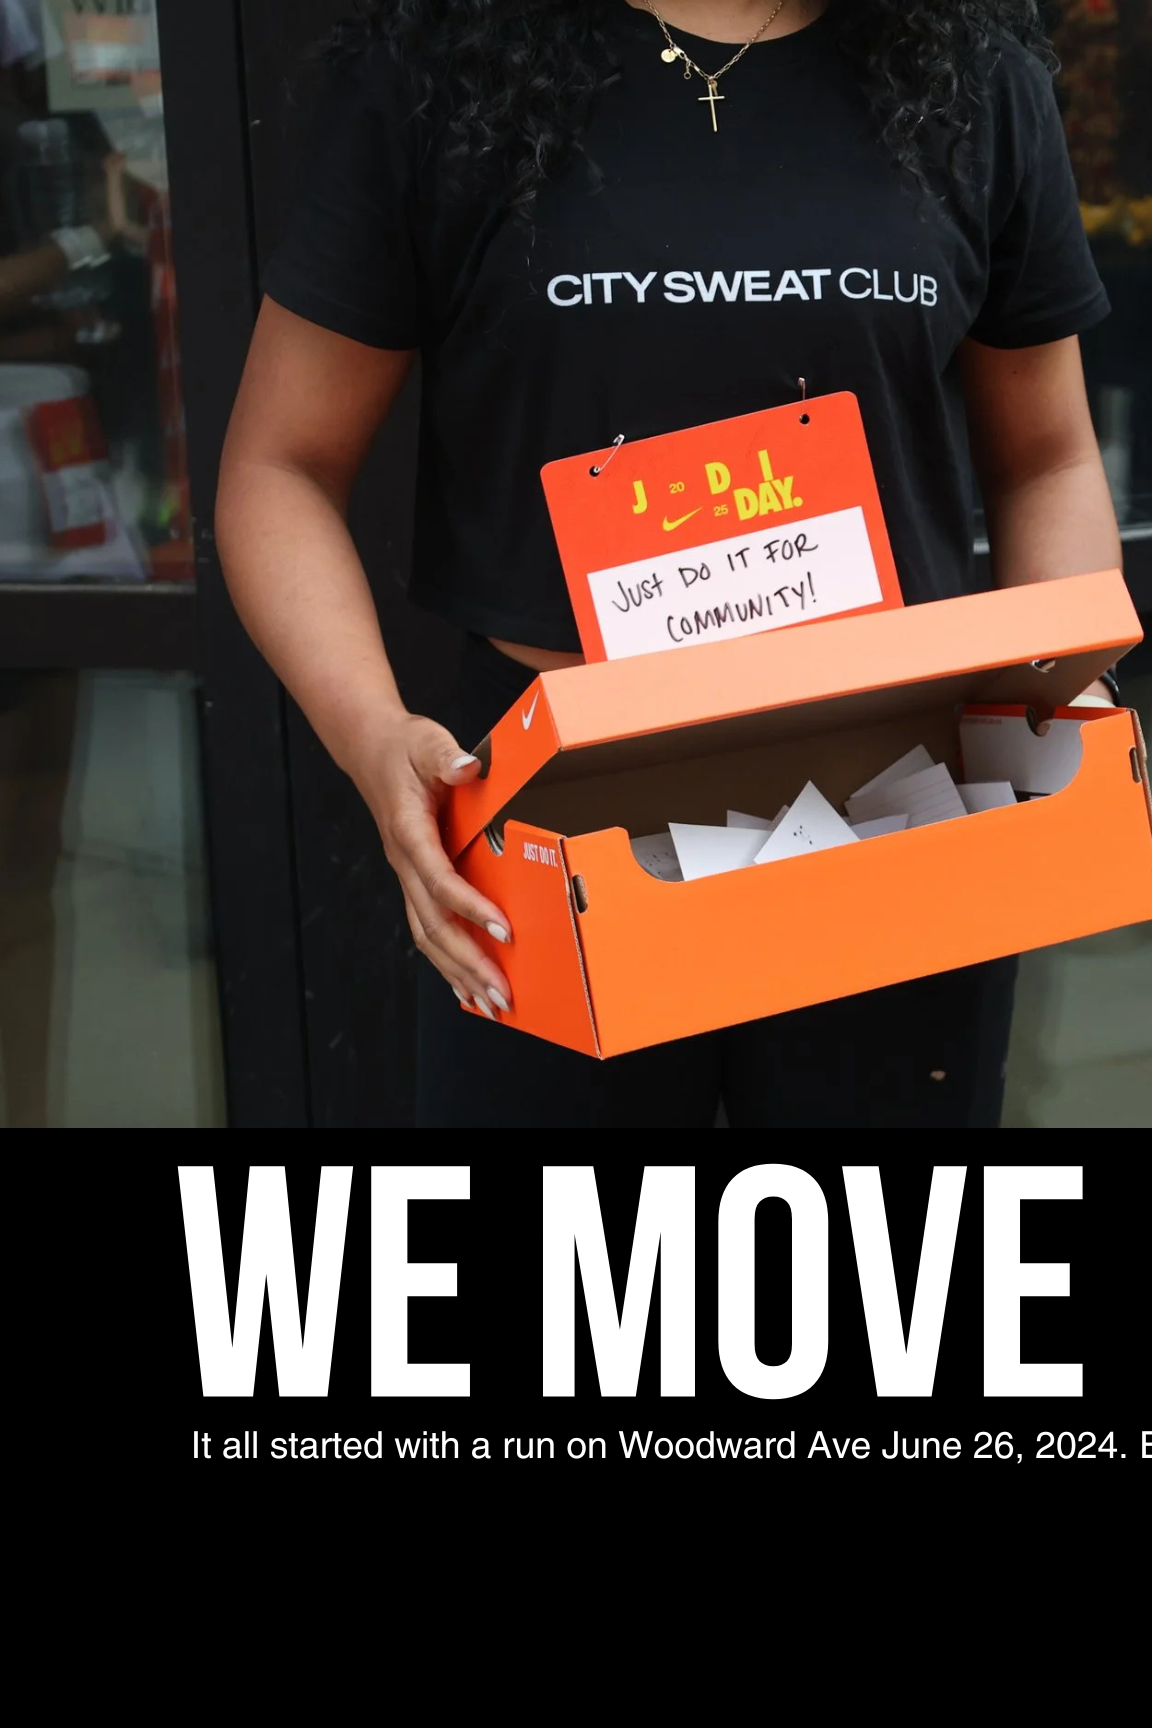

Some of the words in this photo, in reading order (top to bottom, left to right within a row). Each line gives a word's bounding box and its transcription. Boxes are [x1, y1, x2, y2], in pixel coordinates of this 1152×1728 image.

[547, 271, 658, 307] CITY
[663, 268, 832, 304] SWEAT
[838, 267, 938, 307] CLUB
[632, 480, 648, 514] J
[669, 481, 685, 494] 20
[705, 462, 731, 495] D
[758, 449, 773, 483] I
[713, 504, 729, 517] 25
[733, 476, 803, 521] DAY.
[727, 547, 750, 572] IT
[763, 533, 819, 563] FOR
[666, 571, 818, 643] COMMUNITY!
[523, 842, 538, 862] JUST
[539, 845, 550, 866] DO
[549, 848, 559, 868] IT.
